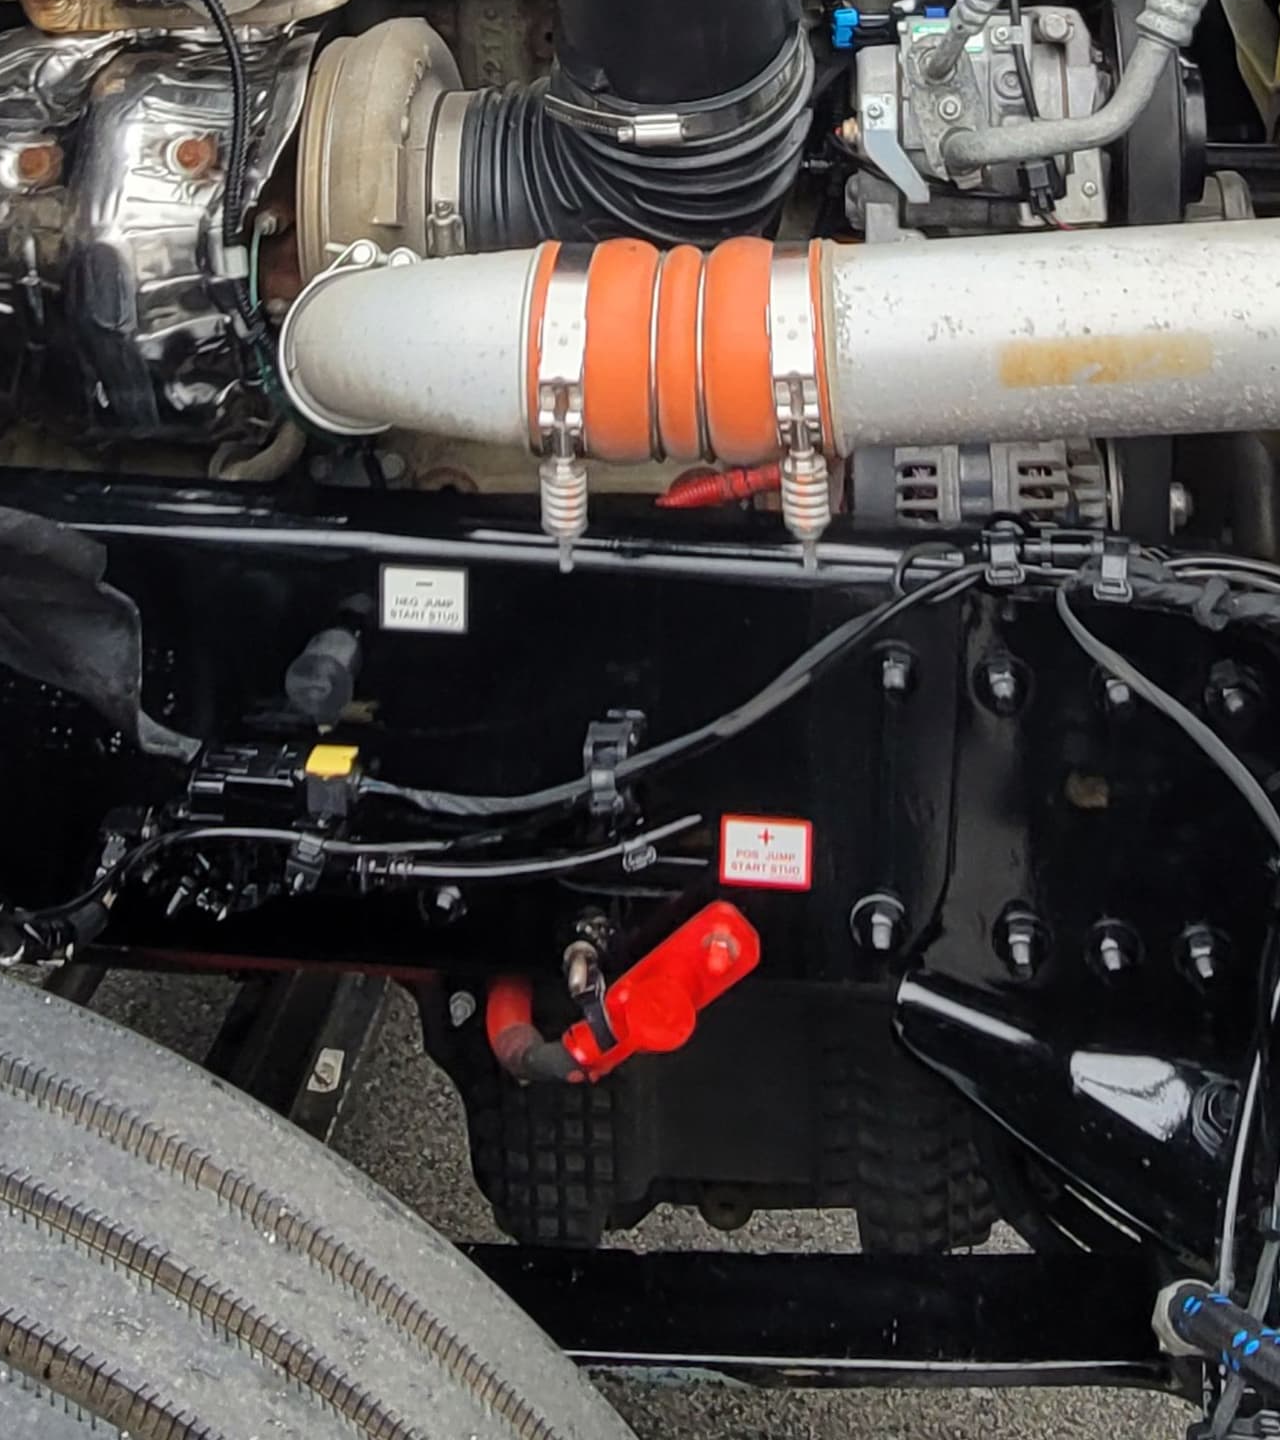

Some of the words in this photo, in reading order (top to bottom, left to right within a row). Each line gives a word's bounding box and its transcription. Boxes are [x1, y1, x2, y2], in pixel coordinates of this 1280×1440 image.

[424, 598, 455, 609] JUMP
[390, 609, 425, 620] START
[428, 611, 460, 623] STUD
[735, 848, 760, 860] POS
[766, 851, 796, 862] JUMP
[730, 861, 766, 873] START
[770, 864, 801, 876] STUD
